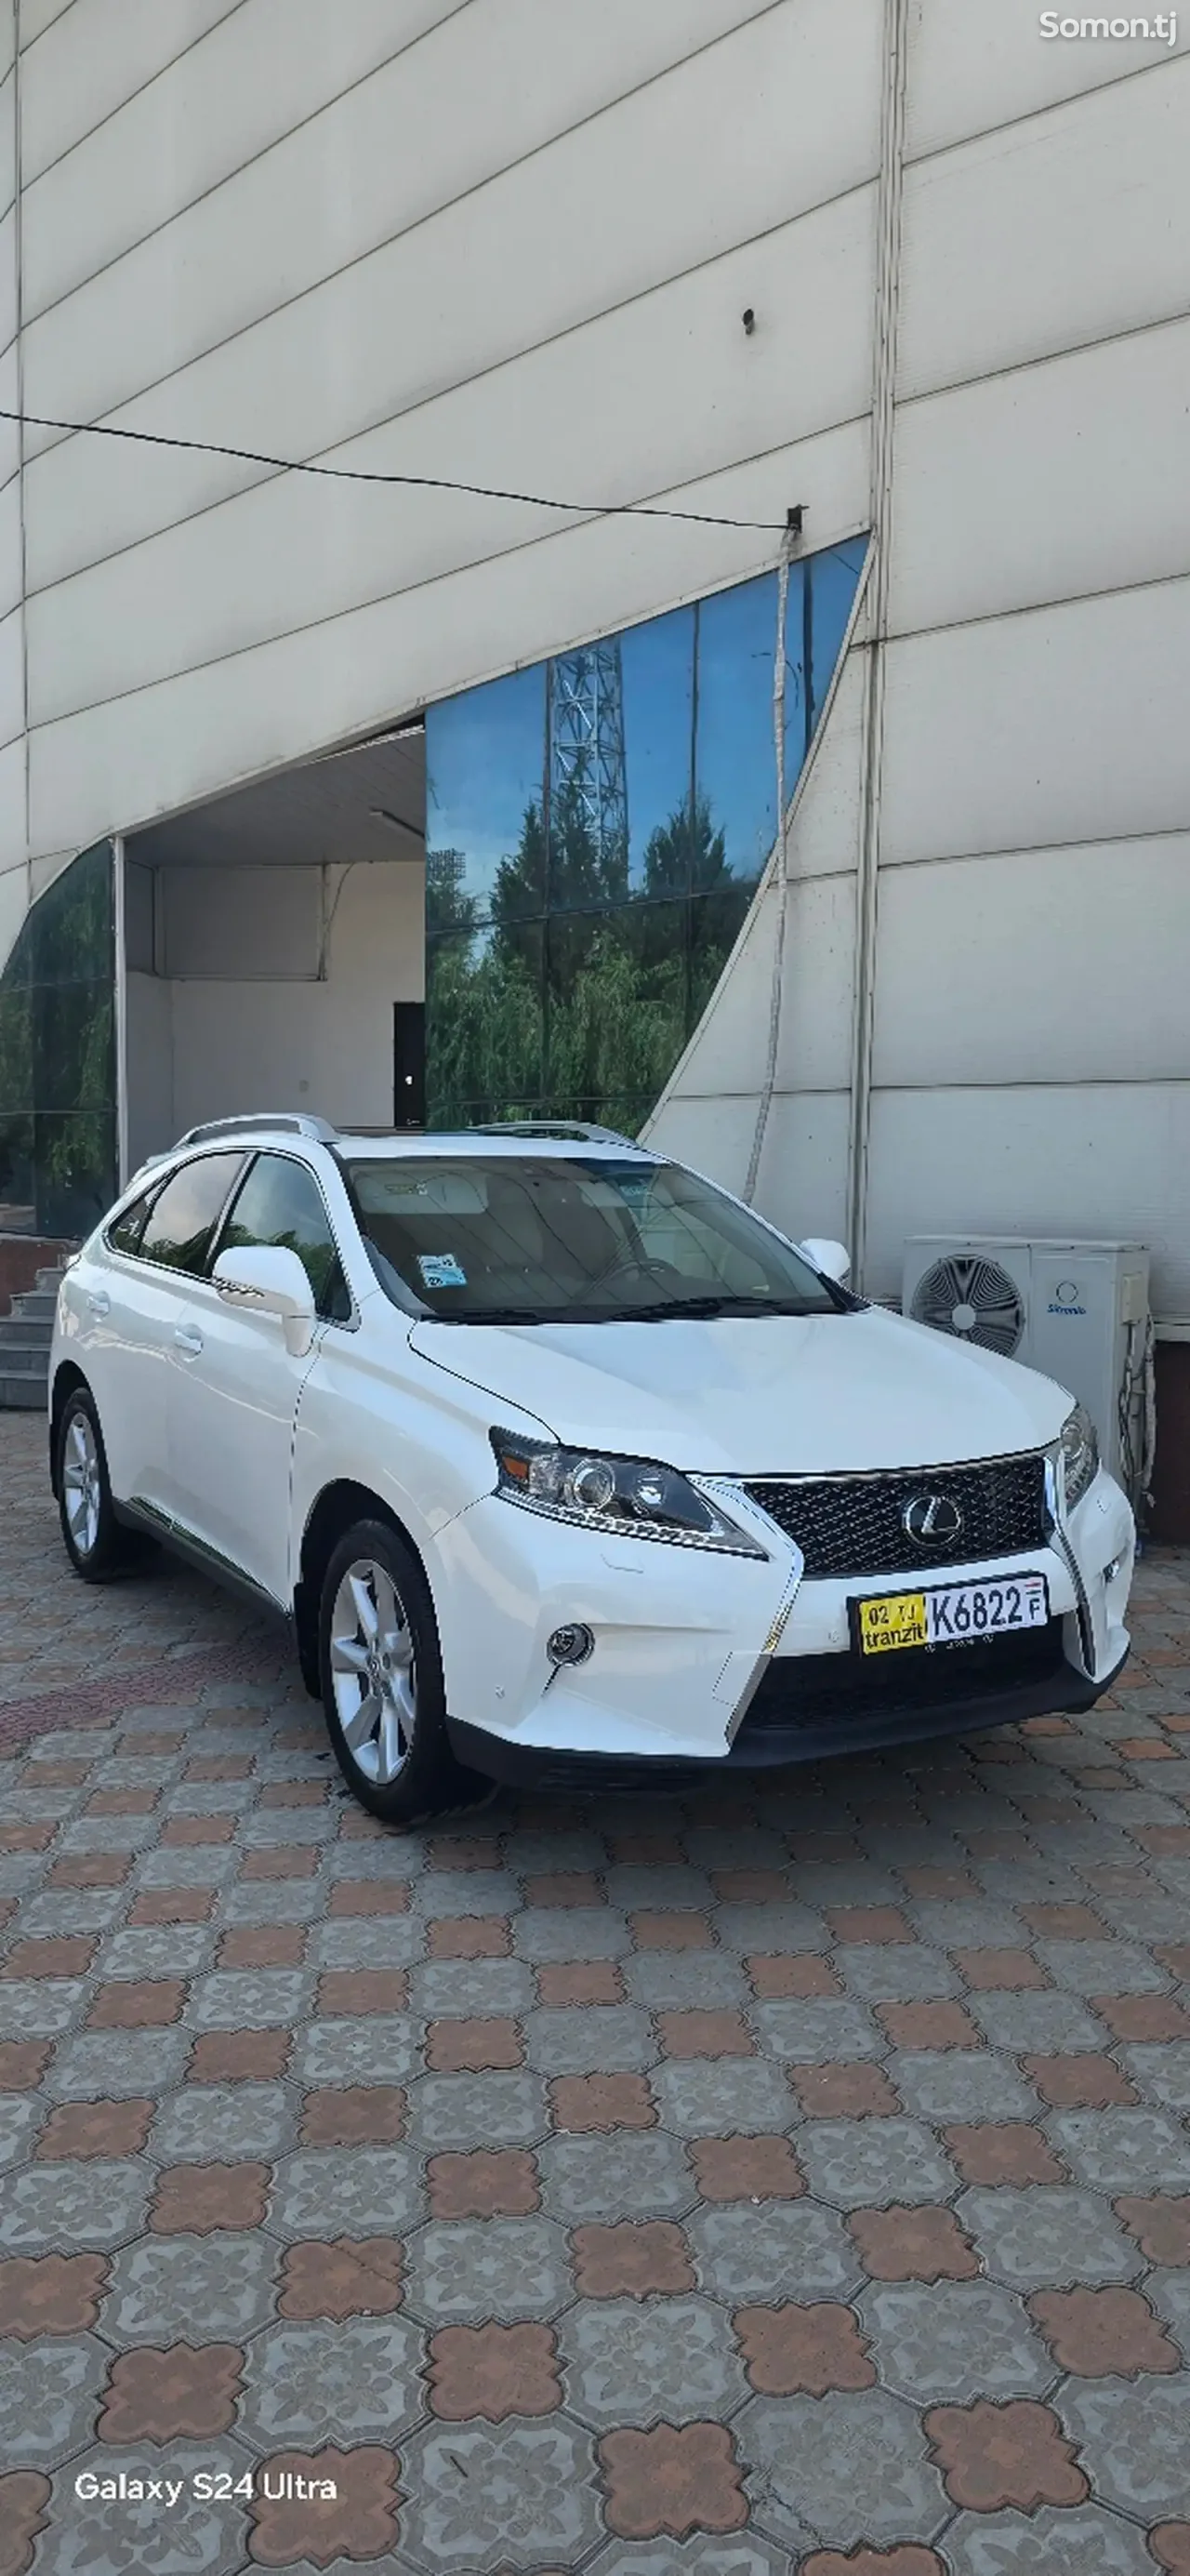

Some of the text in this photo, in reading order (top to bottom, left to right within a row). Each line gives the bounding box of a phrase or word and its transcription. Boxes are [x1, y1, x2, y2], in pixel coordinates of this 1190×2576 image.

[869, 1605, 890, 1626] 02
[932, 1586, 1023, 1637] K6822
[865, 1623, 924, 1649] tranzit
